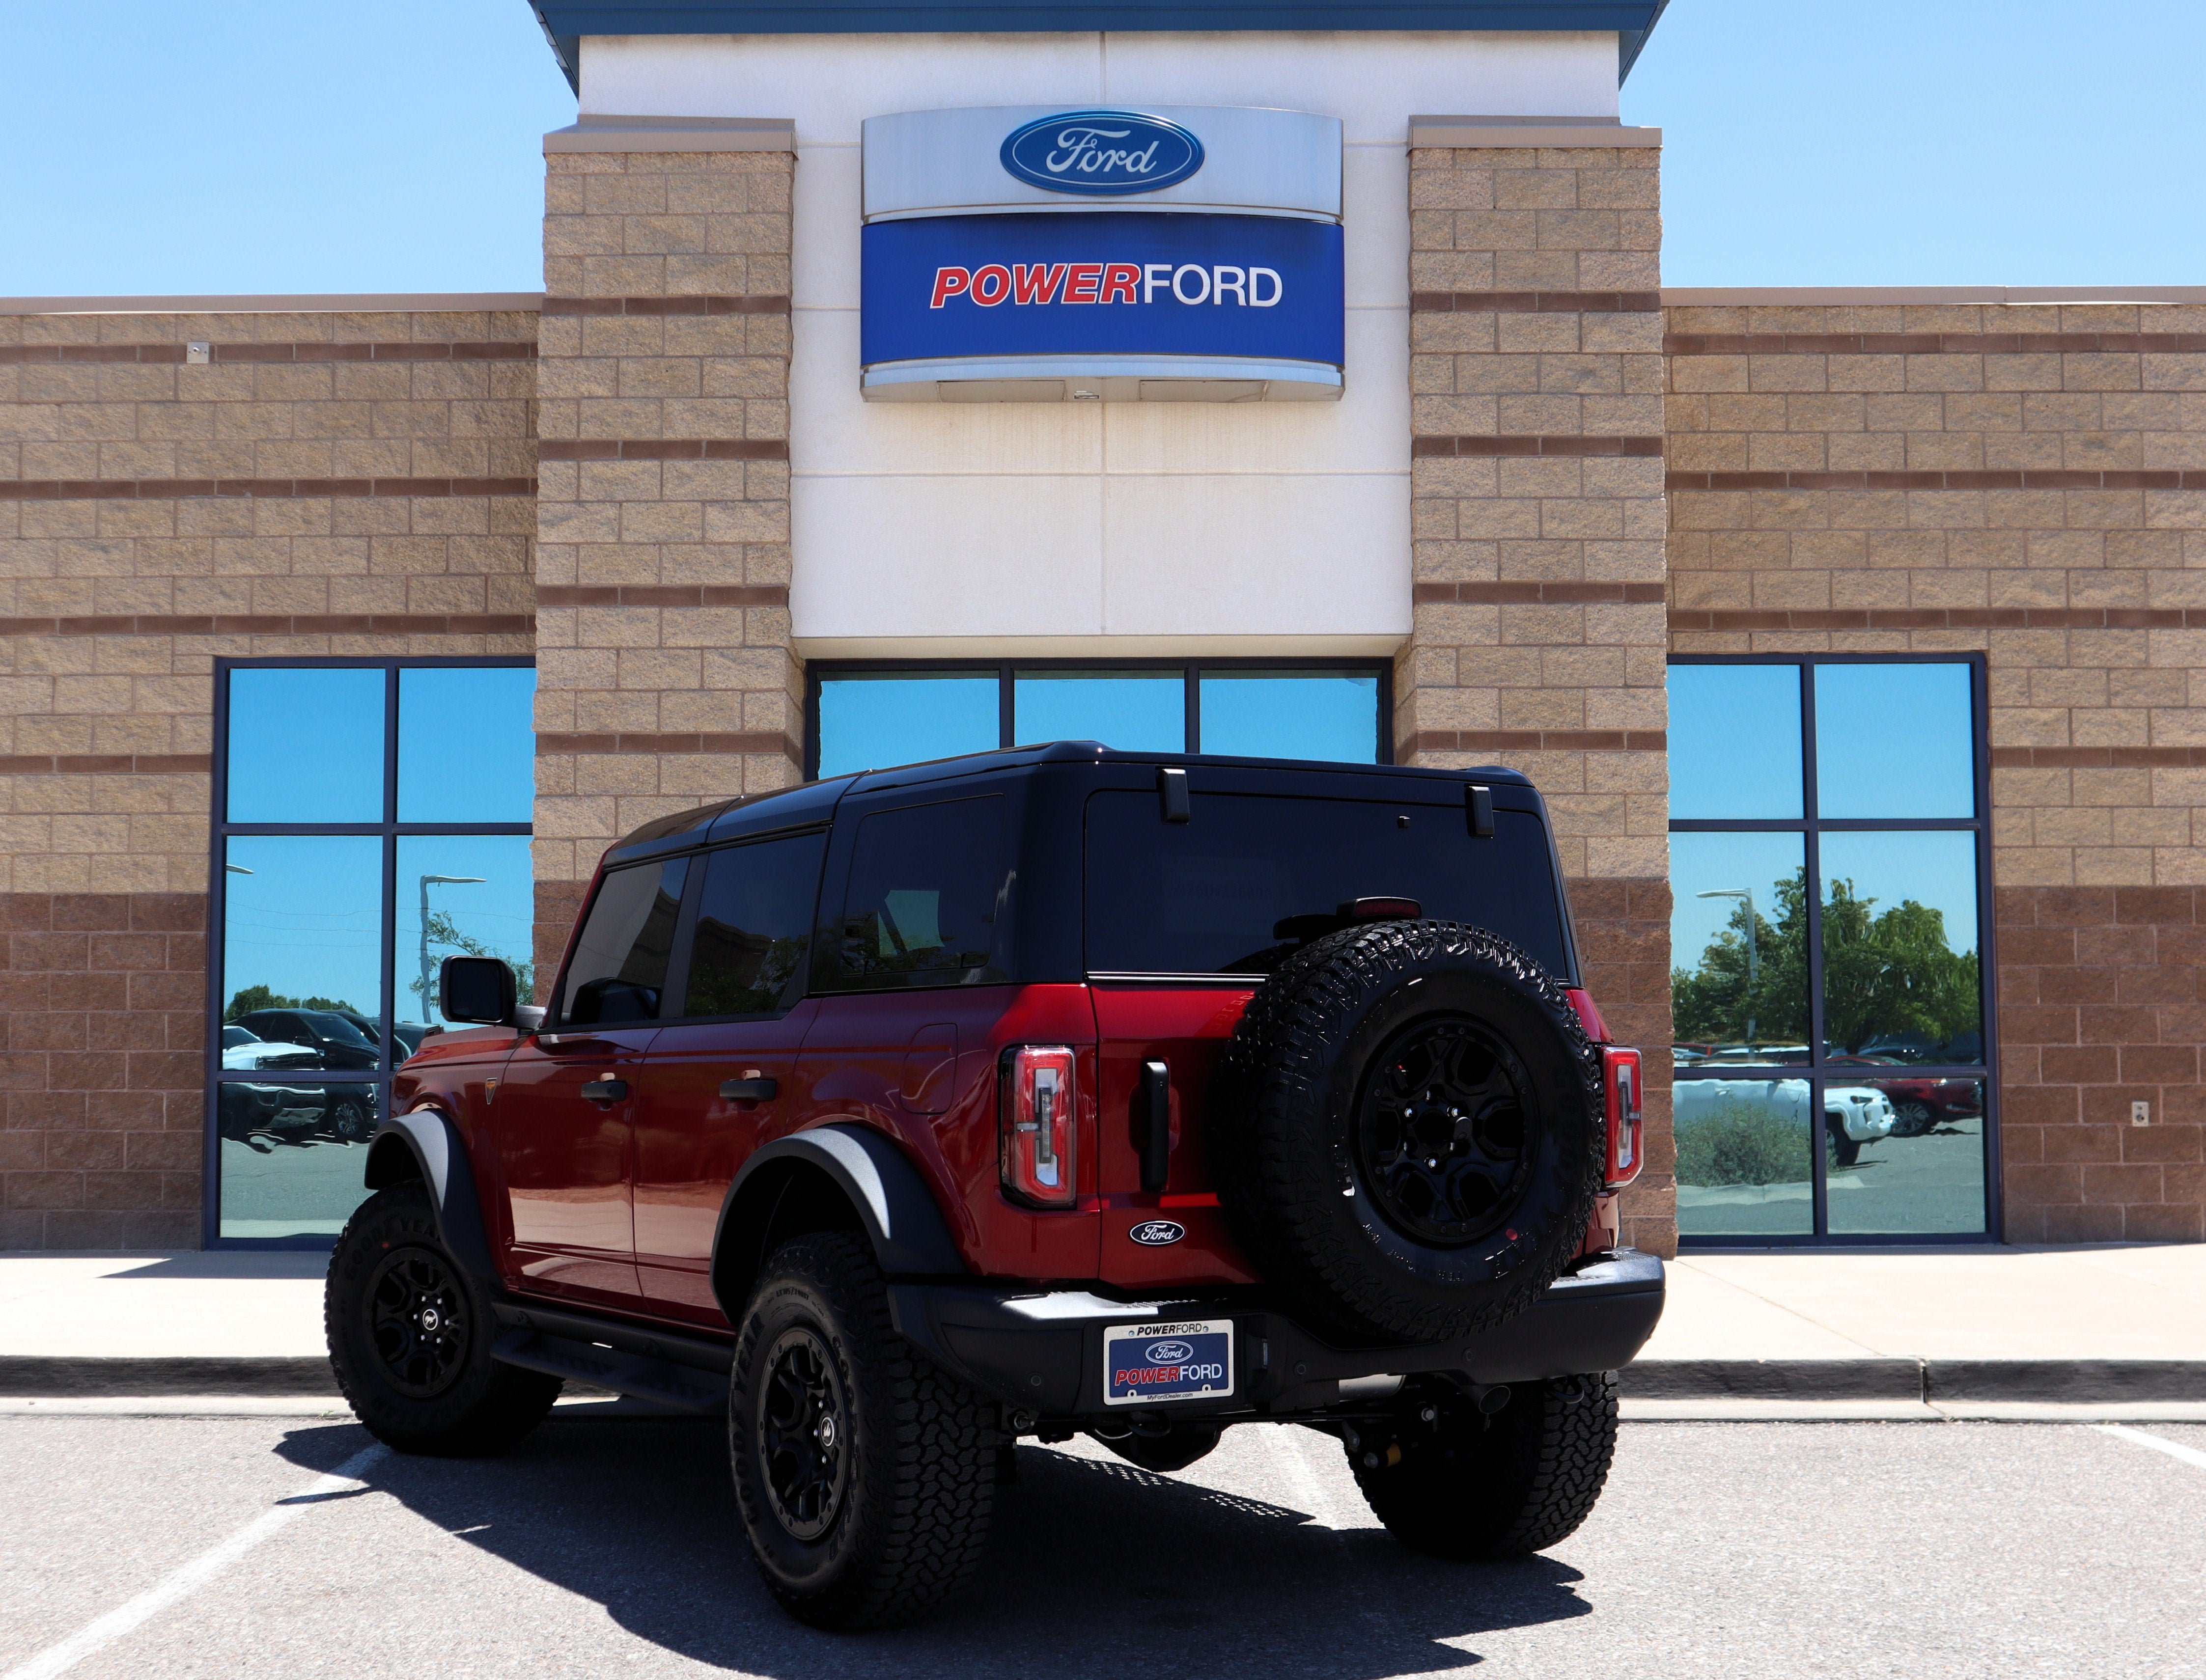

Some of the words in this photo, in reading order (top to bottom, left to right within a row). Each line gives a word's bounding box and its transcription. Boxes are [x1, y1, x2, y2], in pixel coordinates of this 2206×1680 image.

[1046, 127, 1160, 174] Ford
[929, 263, 1283, 309] POWERFORD
[1141, 1224, 1174, 1240] Ford
[1137, 1323, 1202, 1336] POWERFORD
[1155, 1345, 1183, 1359] Ford
[1115, 1363, 1223, 1386] POWERFORD
[1147, 1393, 1193, 1402] MyFordDealer.com
